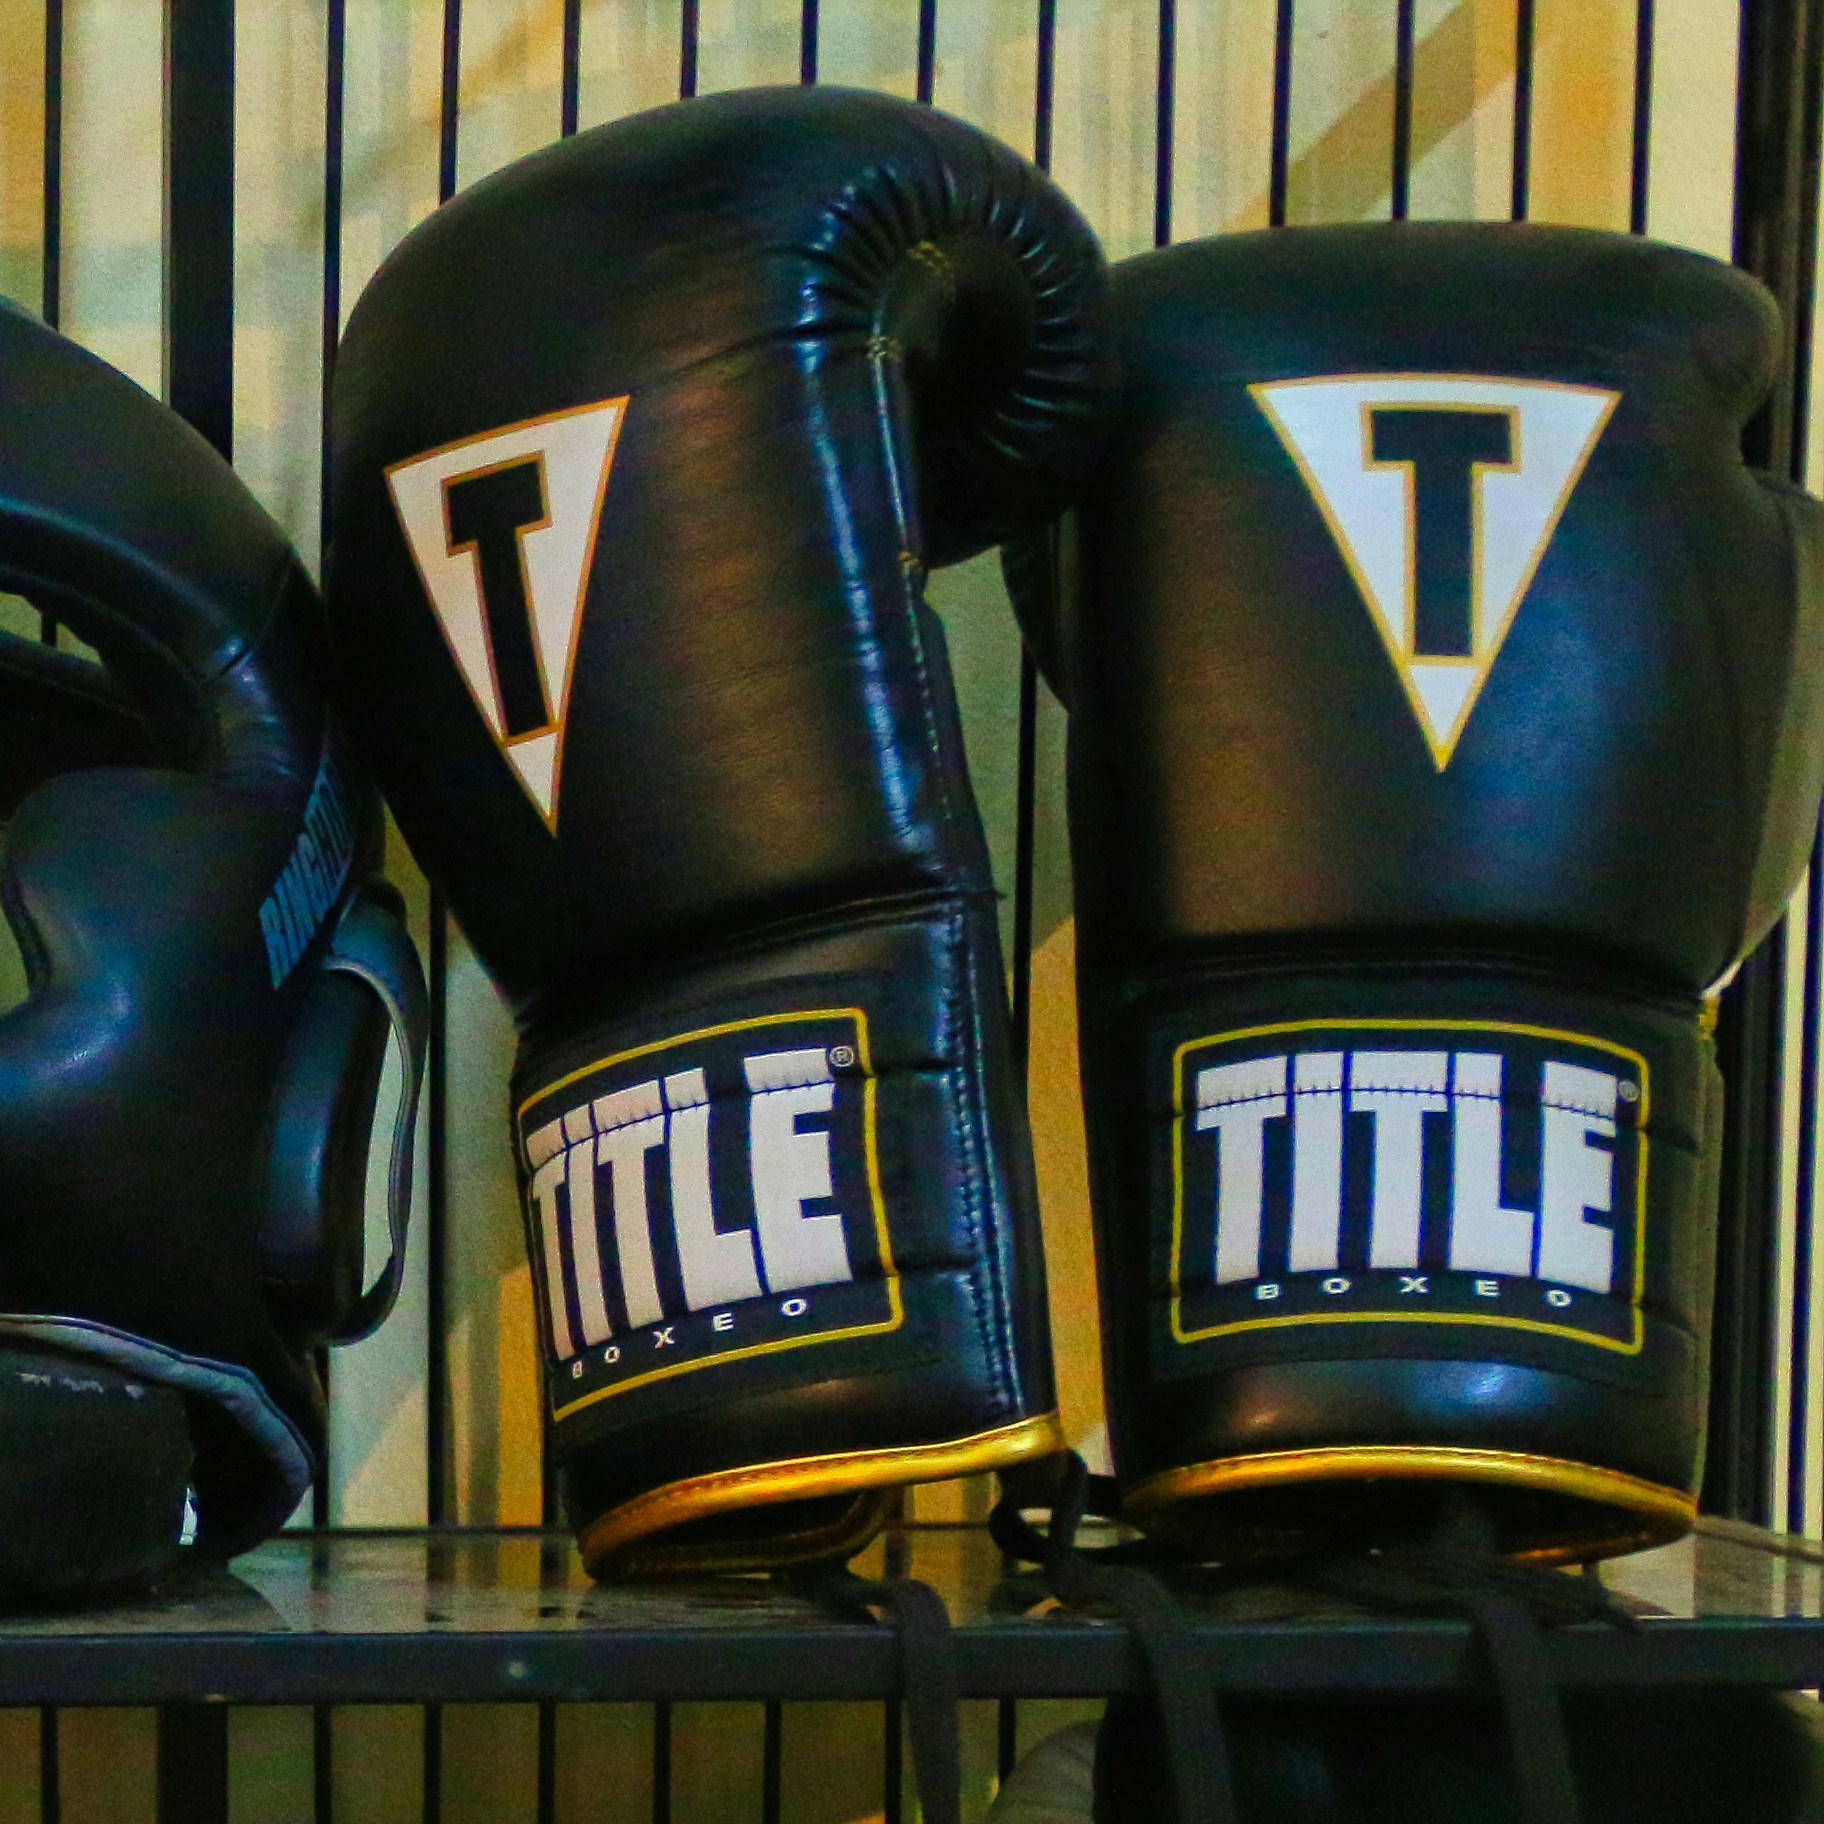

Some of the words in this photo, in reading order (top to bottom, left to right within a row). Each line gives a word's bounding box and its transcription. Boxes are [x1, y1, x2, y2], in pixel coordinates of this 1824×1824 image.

[1196, 1050, 1618, 1294] TITLE
[1255, 1275, 1573, 1308] BOXEO
[571, 1298, 809, 1379] BOXEO
